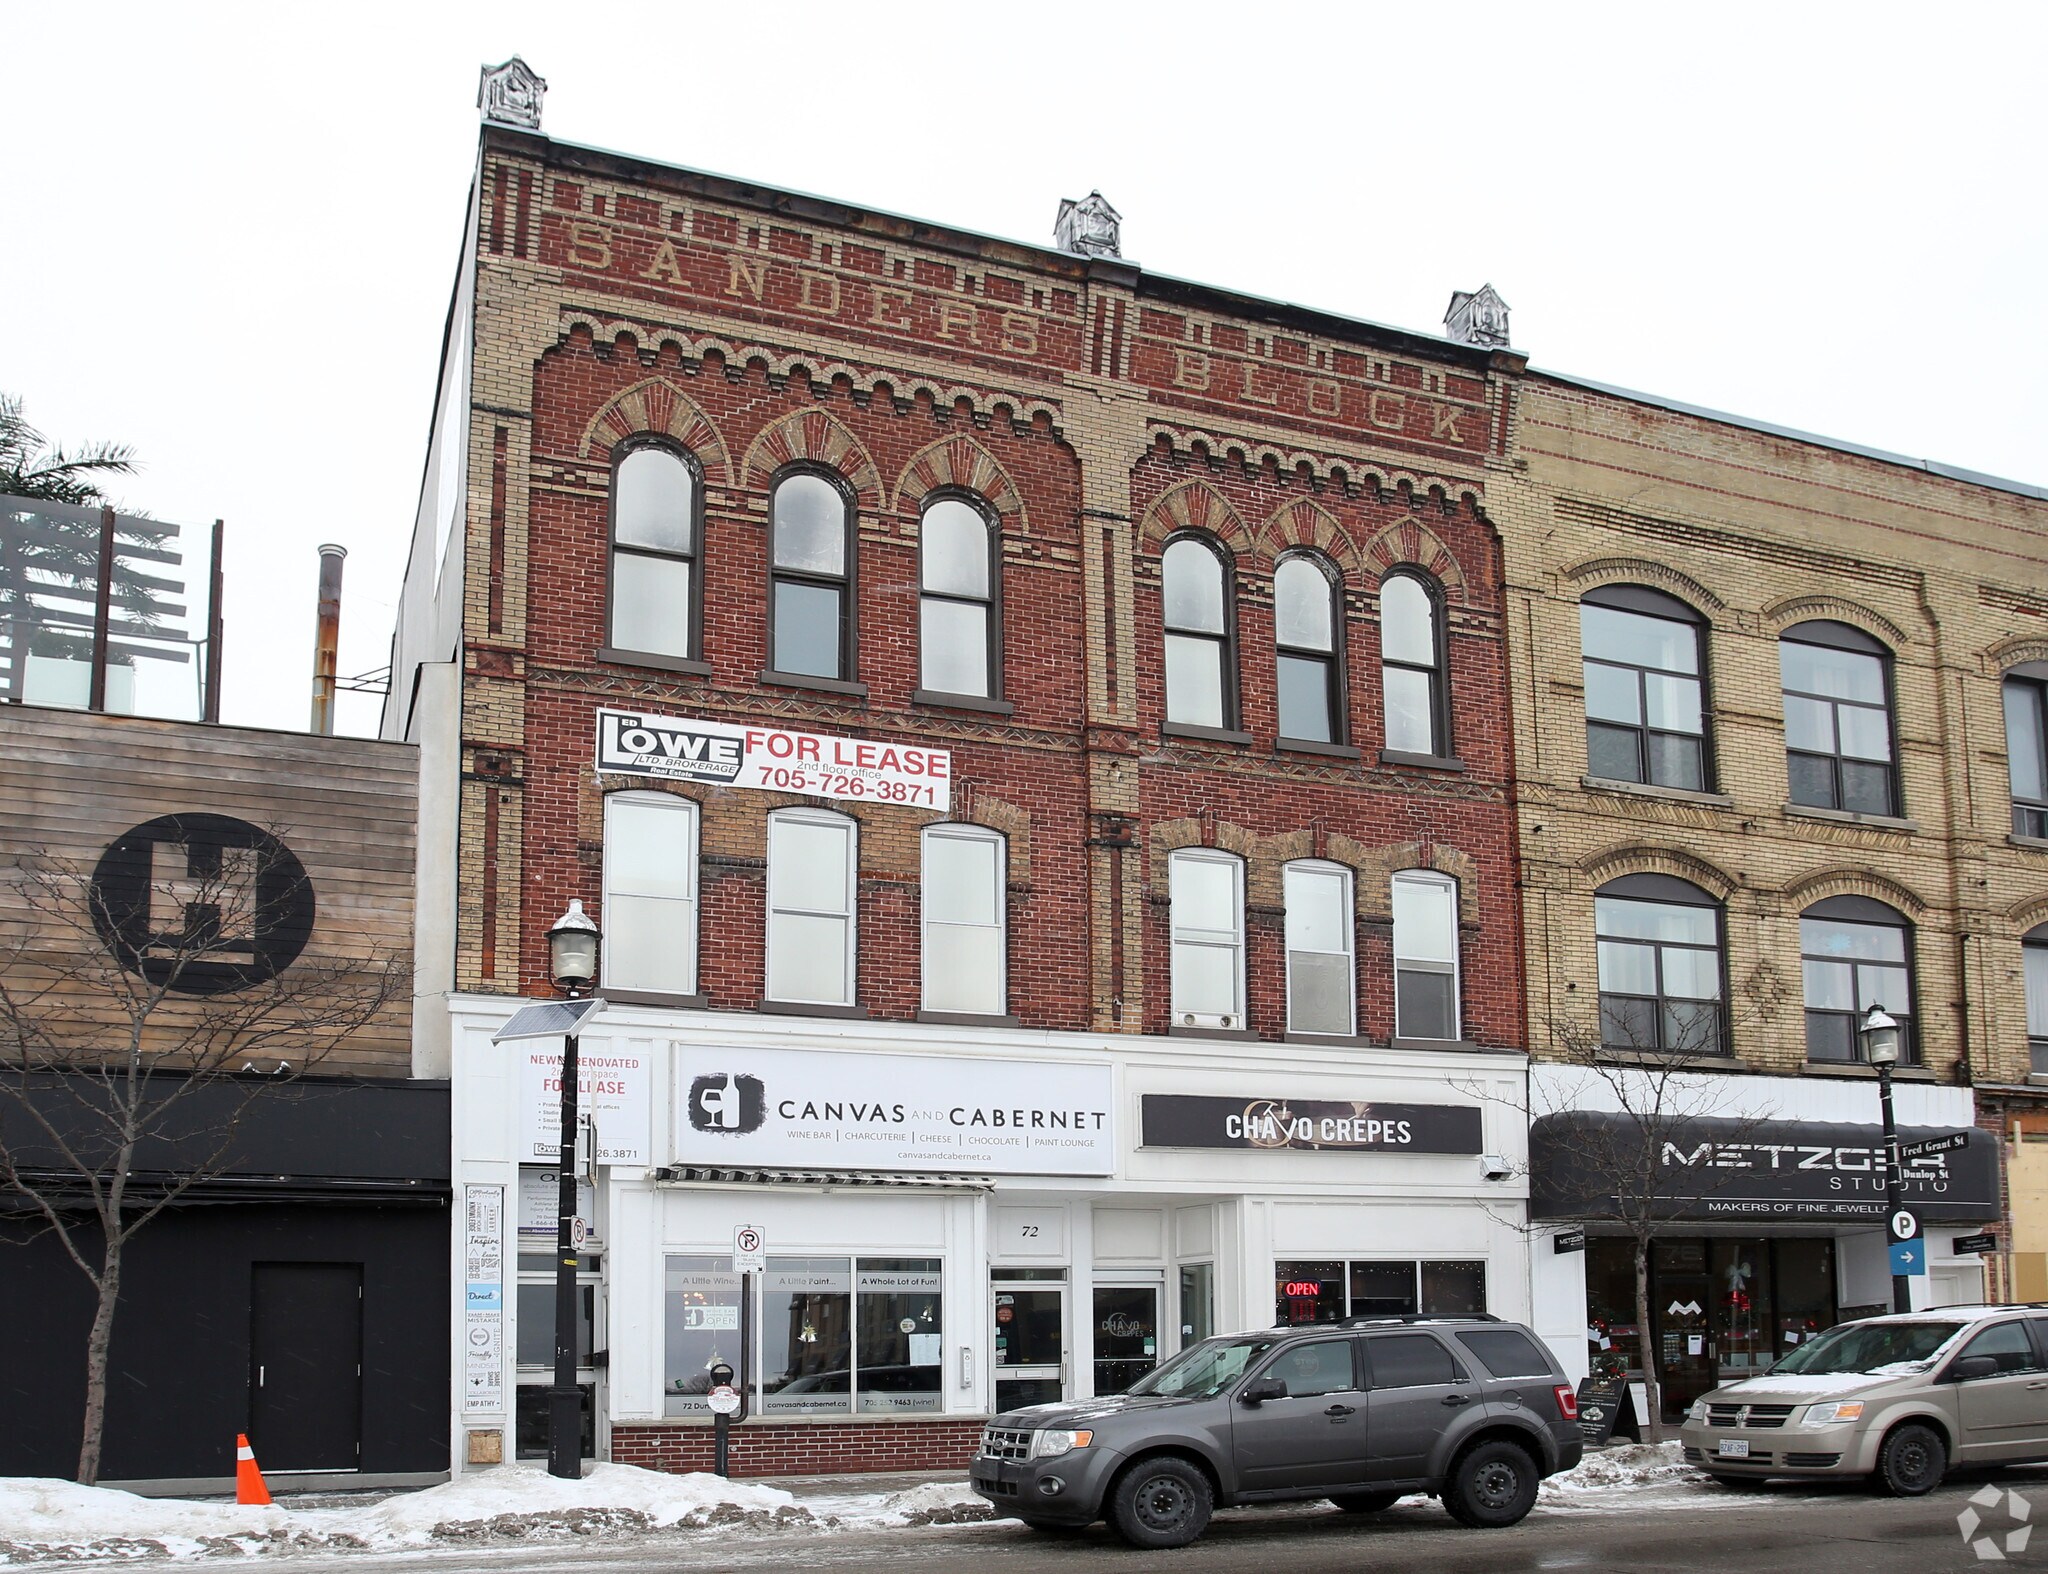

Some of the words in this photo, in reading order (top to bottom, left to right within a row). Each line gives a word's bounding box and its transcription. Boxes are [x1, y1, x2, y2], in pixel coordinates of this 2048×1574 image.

[567, 223, 1039, 356] SANDERS
[1173, 350, 1465, 443] BLOCK
[621, 718, 638, 727] ED
[602, 715, 739, 765] LOWE
[745, 731, 820, 762] FOR
[834, 742, 947, 778] LEASE
[638, 755, 662, 765] LTD.
[665, 758, 737, 774] BROKERAGE
[796, 760, 819, 771] 2nd
[822, 763, 847, 775] floor
[851, 768, 882, 779] office
[650, 767, 667, 775] Real
[669, 769, 693, 778] Estate
[758, 766, 934, 805] 705-726-3871
[149, 842, 258, 941] H
[530, 1055, 563, 1066] NEWL
[593, 1071, 619, 1079] space
[778, 1100, 905, 1123] CANVAS
[911, 1110, 944, 1121] AND
[949, 1107, 1106, 1130] CABERNET
[1321, 1118, 1412, 1144] CREPES
[787, 1130, 811, 1139] WINE
[813, 1131, 832, 1140] BAR
[844, 1132, 907, 1142] CHARCUTERIE
[919, 1134, 952, 1144] CHEESE
[968, 1136, 1020, 1146] CHOCOLATE
[1034, 1138, 1058, 1147] PAINT
[1060, 1139, 1095, 1148] LOUNGE
[1902, 1144, 1922, 1157] Fred
[1925, 1139, 1952, 1153] Grant
[1954, 1135, 1965, 1146] St
[897, 1150, 992, 1161] canvasandcabernet.ca
[1903, 1169, 1936, 1181] Dunlop
[1939, 1168, 1950, 1179] St
[1709, 1203, 1770, 1212] MAKERS
[1774, 1203, 1794, 1212] OF
[1798, 1204, 1828, 1213] FINE
[1022, 1226, 1039, 1237] 72
[468, 1235, 500, 1247] Inspire
[692, 1277, 711, 1285] Little
[870, 1278, 895, 1286] Whole
[897, 1278, 909, 1286] Lot
[911, 1278, 919, 1286] of
[921, 1278, 937, 1286] Fun!
[1286, 1282, 1318, 1296] OPEN
[468, 1291, 493, 1300] Direct
[707, 1317, 736, 1325] OPEN
[468, 1351, 491, 1359] Friendly
[767, 1399, 847, 1408] canvasandcabernet.ca
[894, 1399, 911, 1407] 9463
[913, 1398, 935, 1407] (wine)
